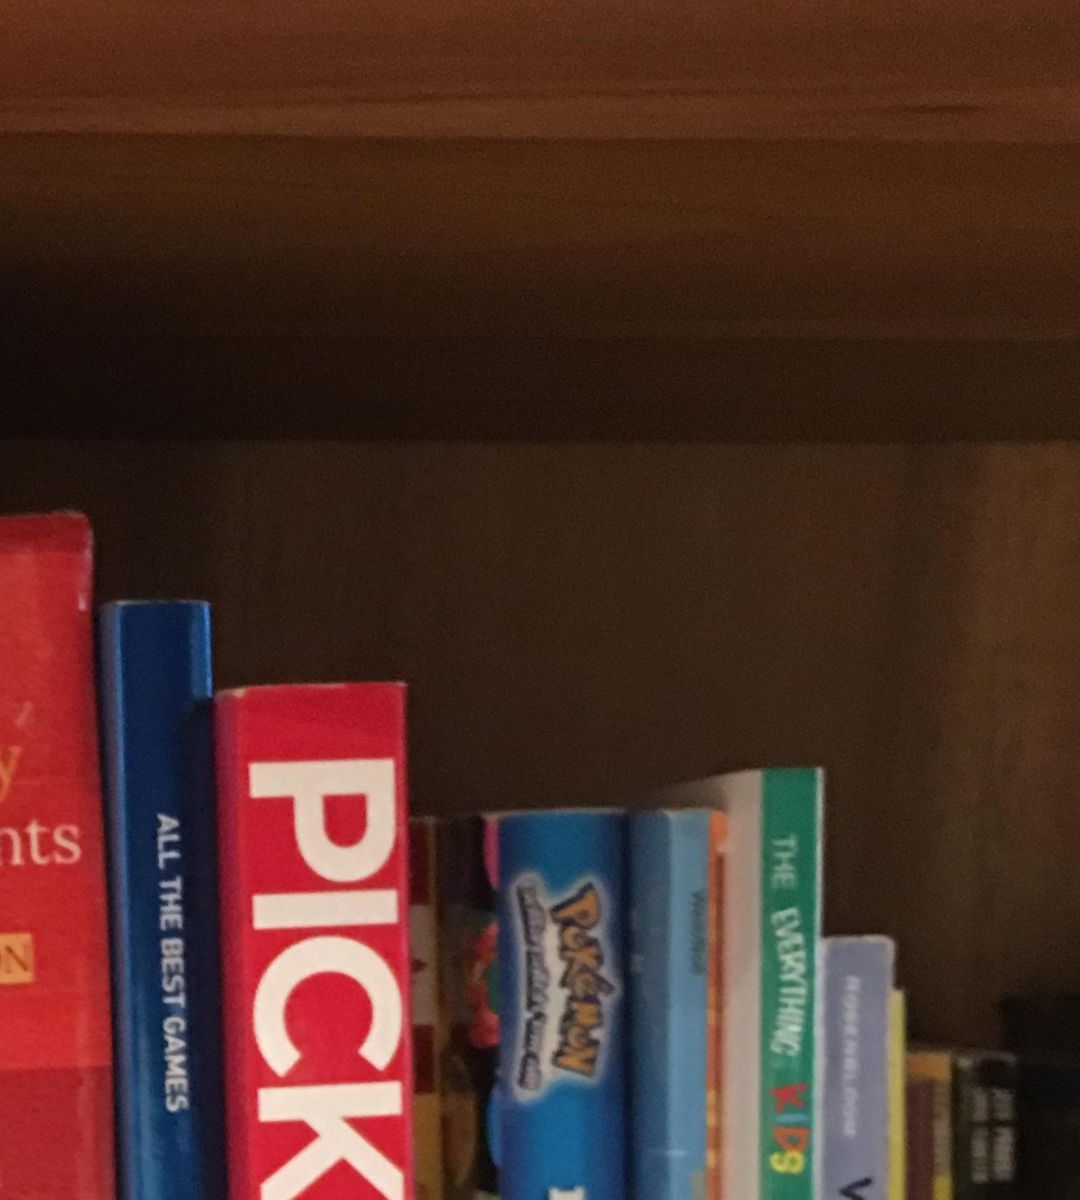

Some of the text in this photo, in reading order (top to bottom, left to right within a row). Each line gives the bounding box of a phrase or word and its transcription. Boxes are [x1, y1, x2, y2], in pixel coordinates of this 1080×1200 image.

[771, 834, 798, 890] THE
[156, 814, 191, 1113] ALL THE BEST GAMES
[771, 907, 807, 1058] EVERYTHING
